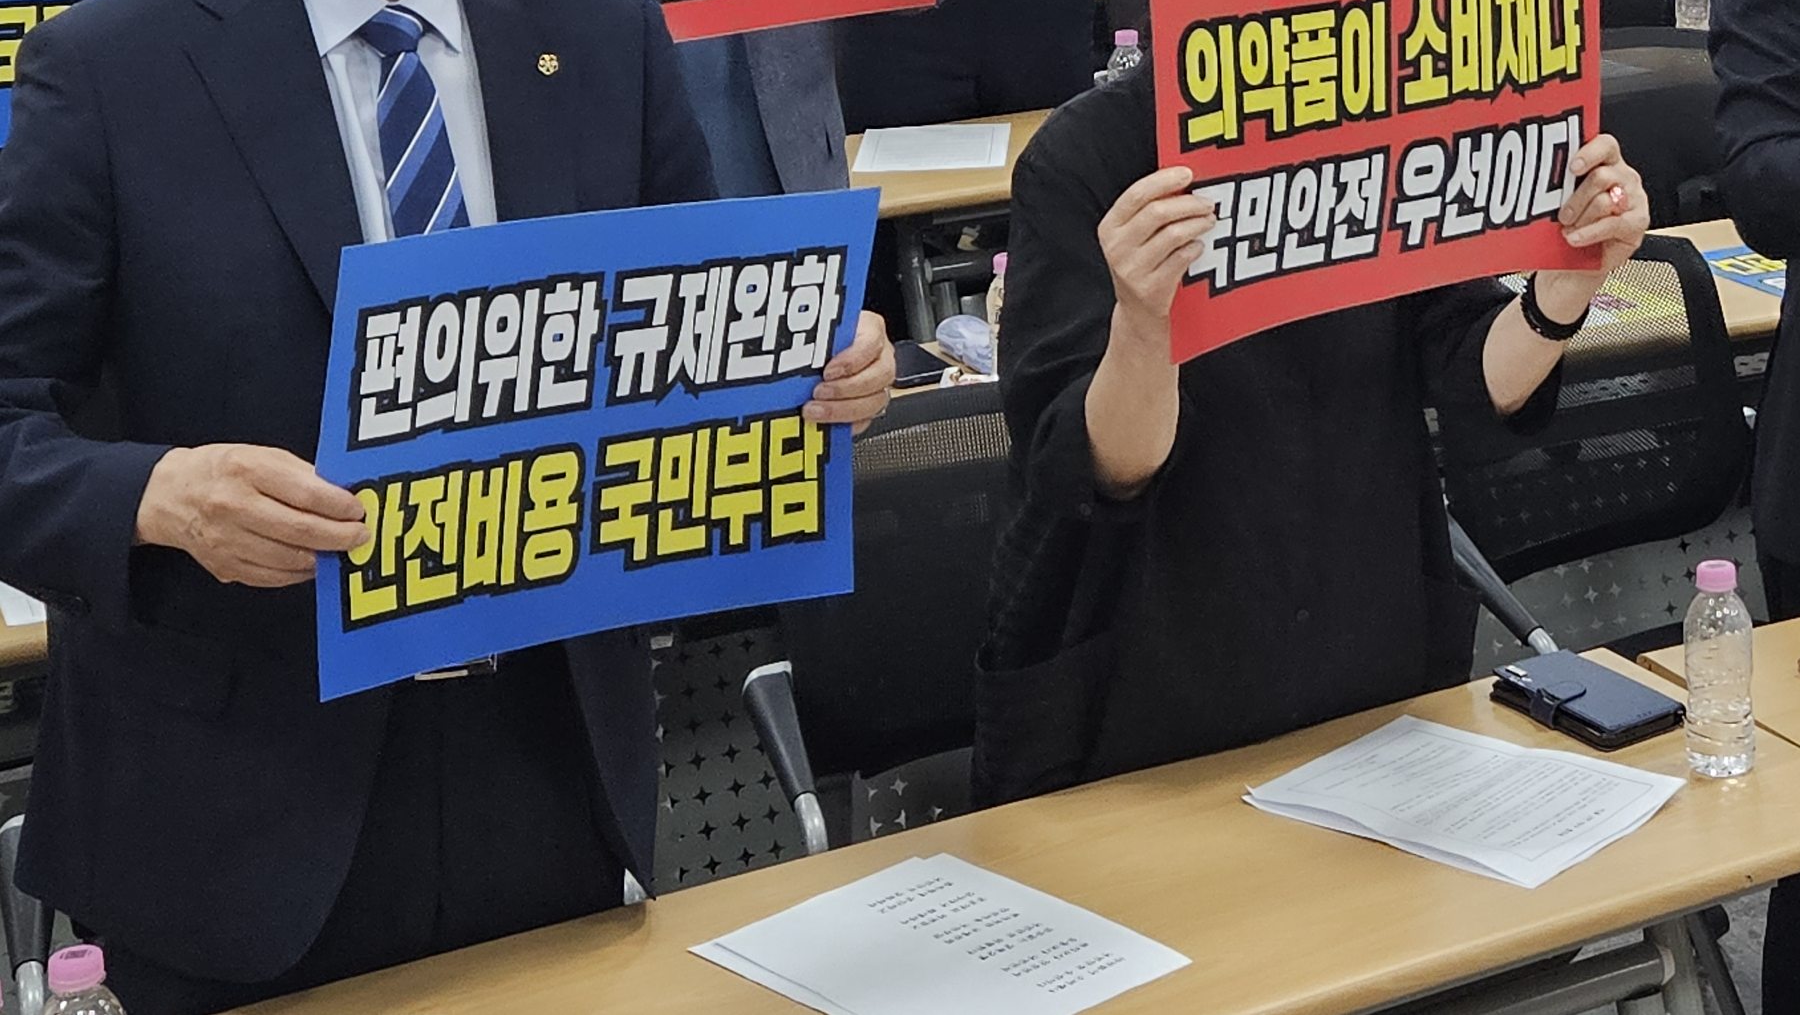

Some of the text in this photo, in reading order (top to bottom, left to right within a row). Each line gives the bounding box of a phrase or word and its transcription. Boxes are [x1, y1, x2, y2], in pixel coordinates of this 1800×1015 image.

[1184, 0, 1386, 146] 의약품이
[1186, 114, 1582, 290] 국민안전 우선이다
[357, 253, 843, 442] 편의위한 규제완화
[346, 413, 826, 622] 안전비용 국민부담
